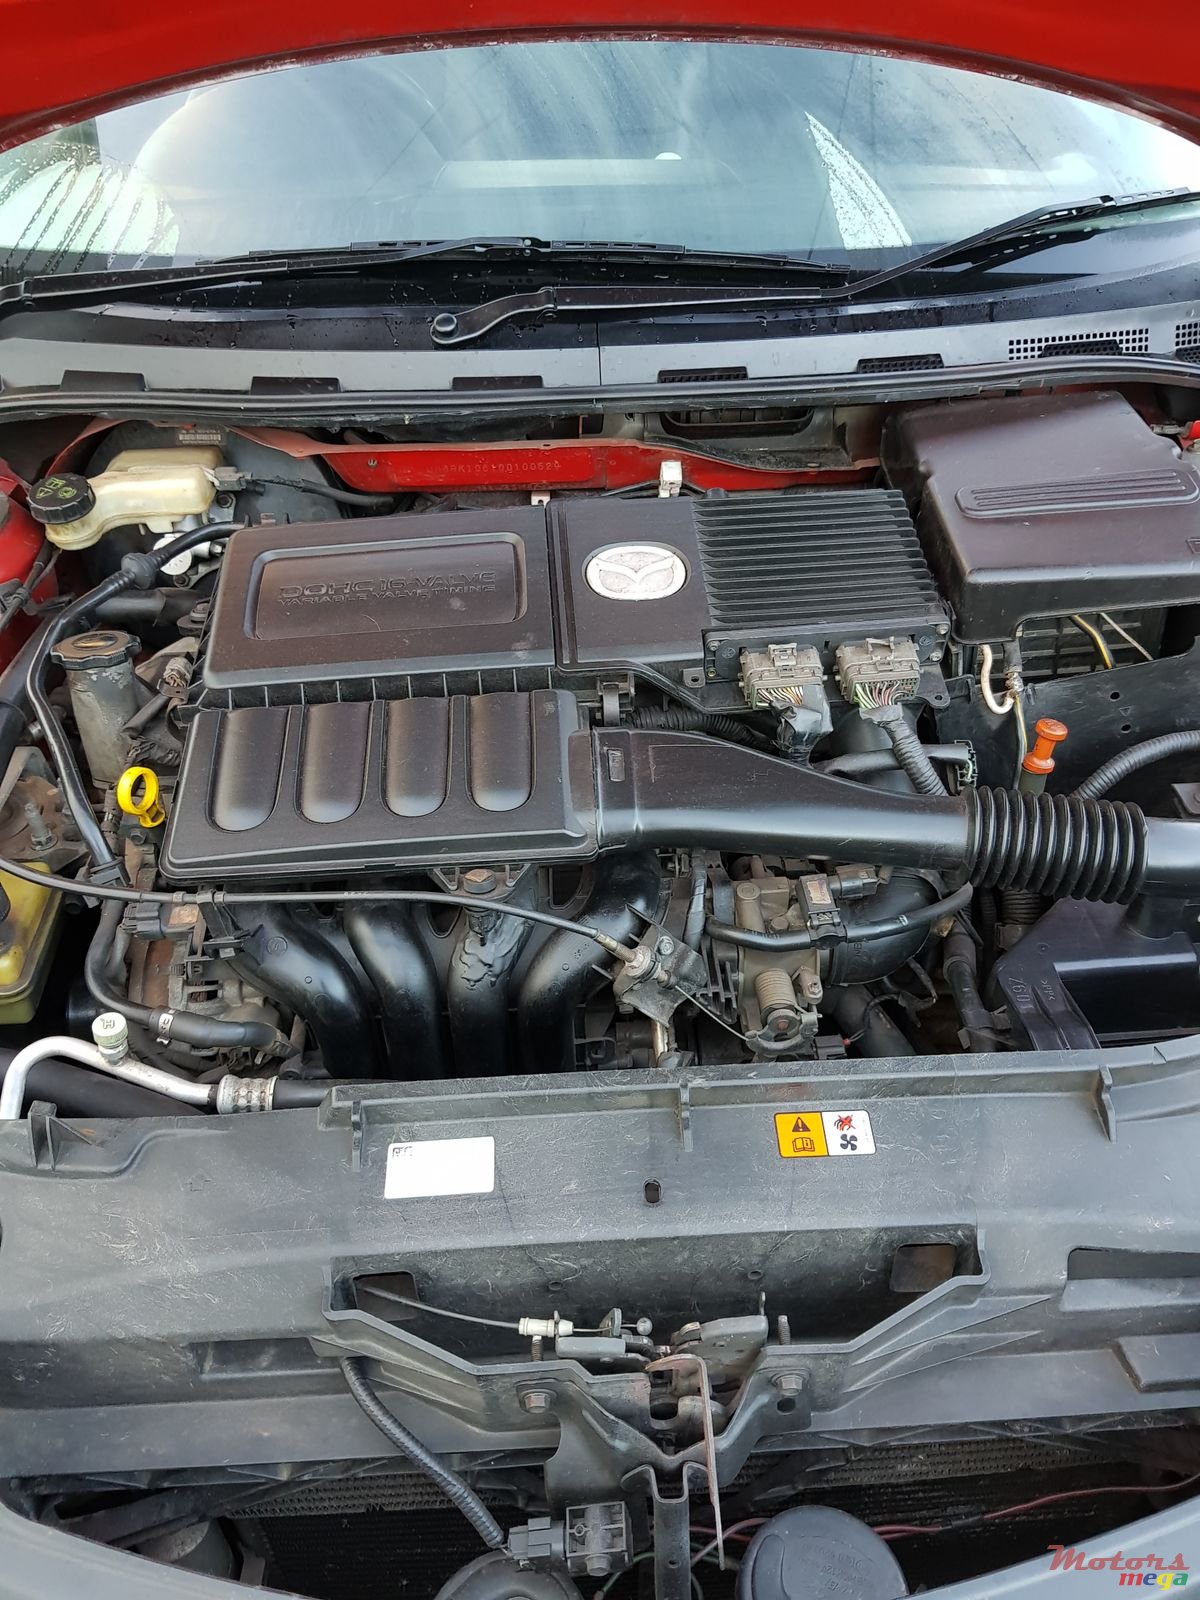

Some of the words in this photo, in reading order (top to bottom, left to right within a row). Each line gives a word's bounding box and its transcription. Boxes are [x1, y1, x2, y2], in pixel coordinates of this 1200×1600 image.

[278, 593, 368, 607] VARIABLE
[374, 588, 430, 600] VALVE
[432, 584, 497, 595] TIMING
[279, 579, 375, 598] DOHC
